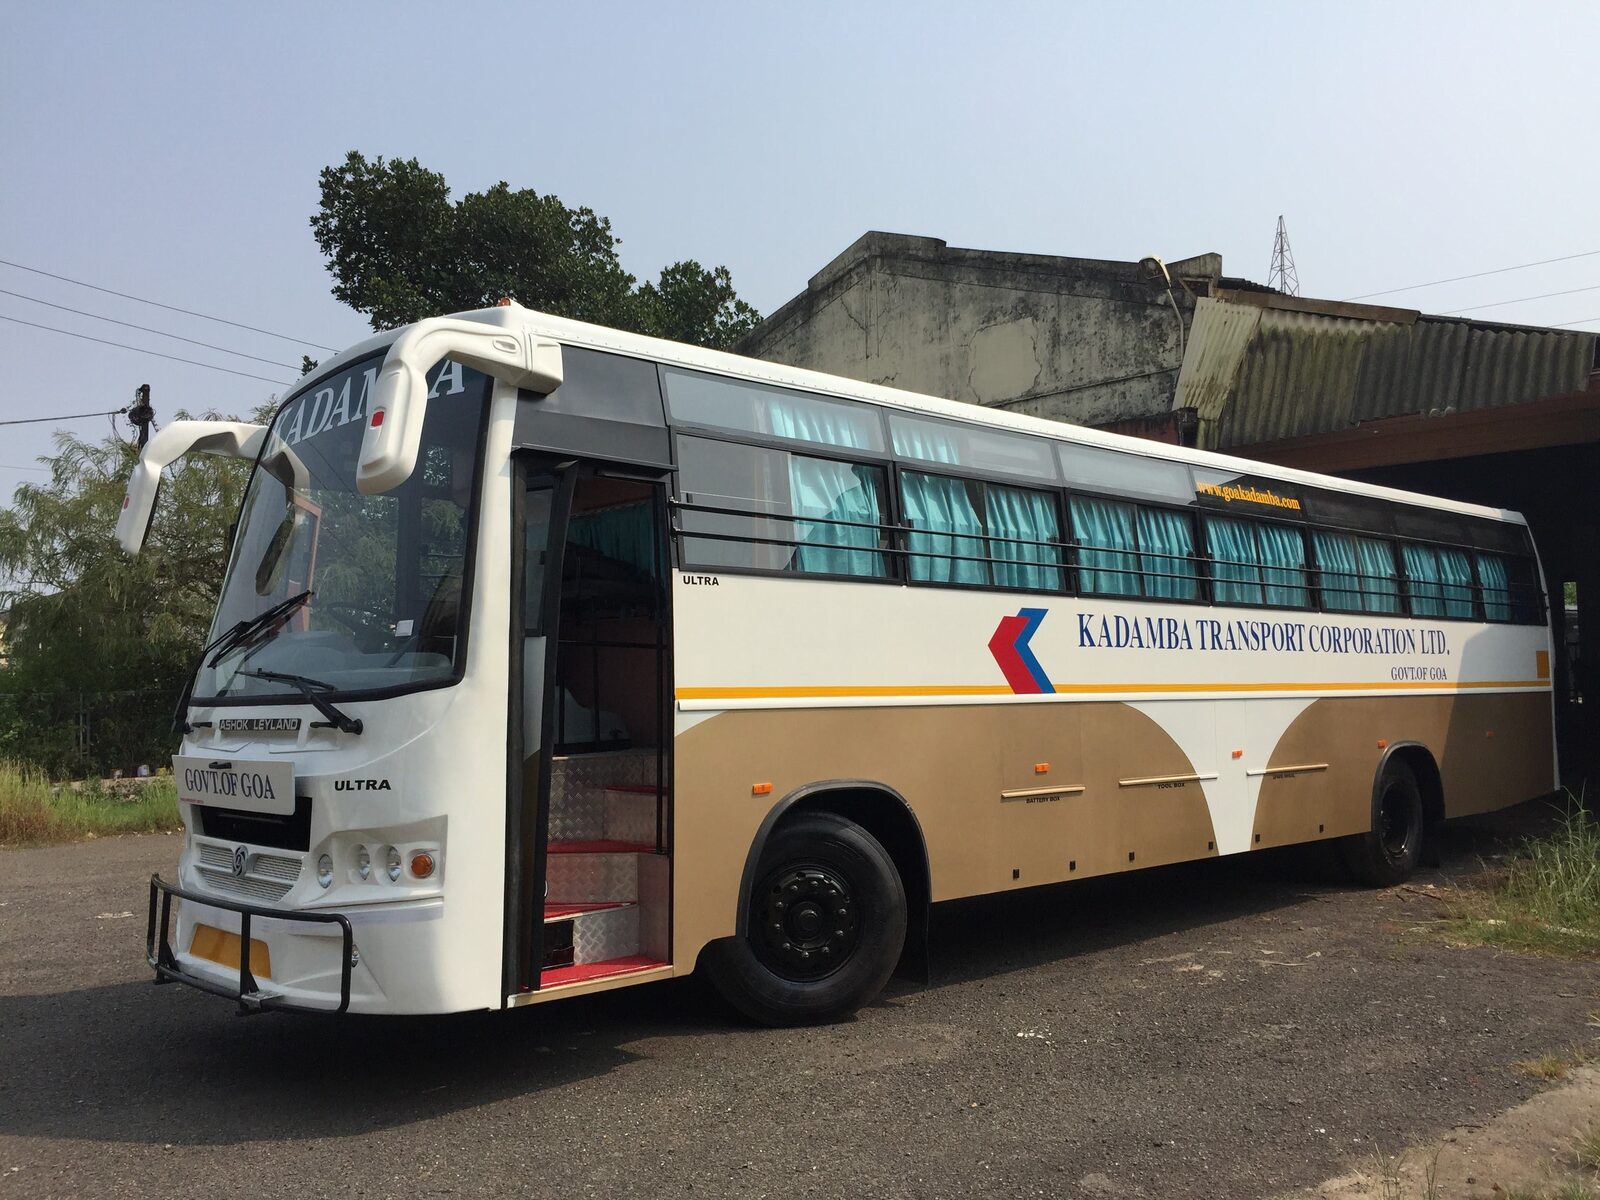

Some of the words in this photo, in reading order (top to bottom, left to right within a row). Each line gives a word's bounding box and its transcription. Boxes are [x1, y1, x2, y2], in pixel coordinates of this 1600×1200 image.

[262, 359, 465, 460] KADAA
[1196, 482, 1301, 510] www.goakadamba.com
[682, 575, 720, 586] ULTRA
[1077, 613, 1193, 650] KADAMBA
[1196, 619, 1305, 652] TRANSPORT
[1309, 625, 1416, 655] CORPORATION
[1420, 629, 1450, 656] LTD.
[1429, 667, 1448, 680] GOA
[219, 719, 249, 730] ASHOK
[253, 719, 299, 731] LEYLAND
[240, 772, 276, 800] GOA
[334, 779, 392, 791] ULTRA
